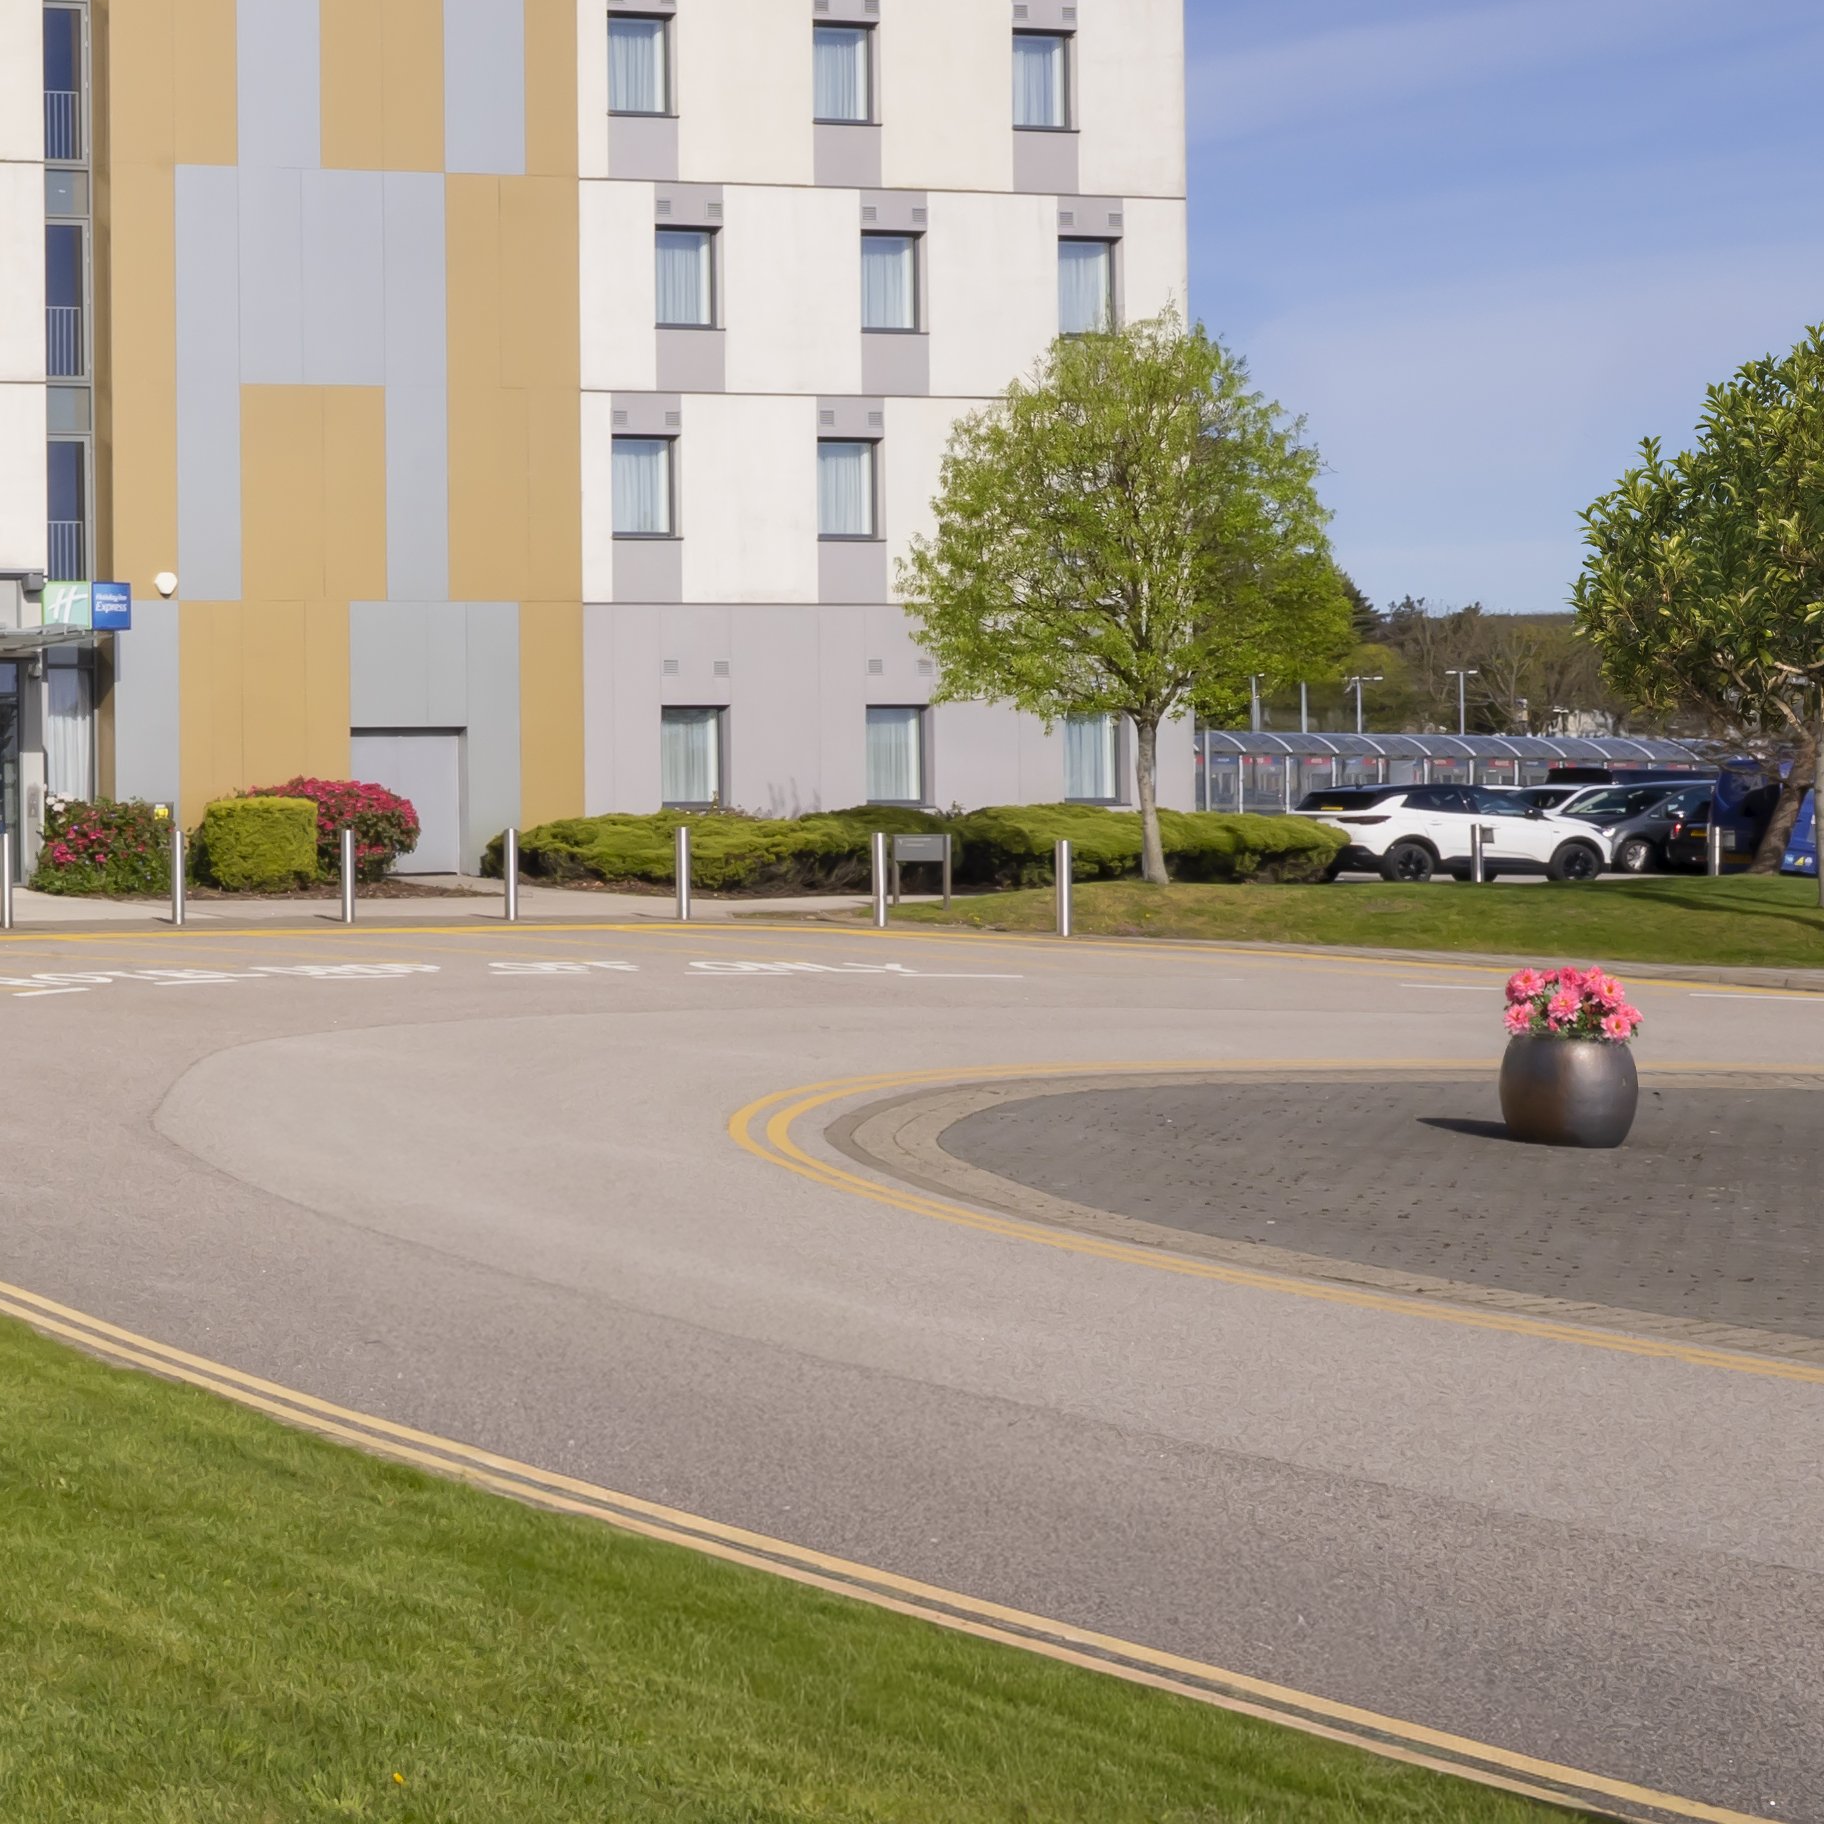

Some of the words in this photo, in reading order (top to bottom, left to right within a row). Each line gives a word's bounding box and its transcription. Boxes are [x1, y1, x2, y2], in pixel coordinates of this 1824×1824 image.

[95, 601, 127, 613] Express
[249, 963, 440, 976] DROP
[487, 961, 640, 972] OFF
[688, 961, 919, 973] ONLY
